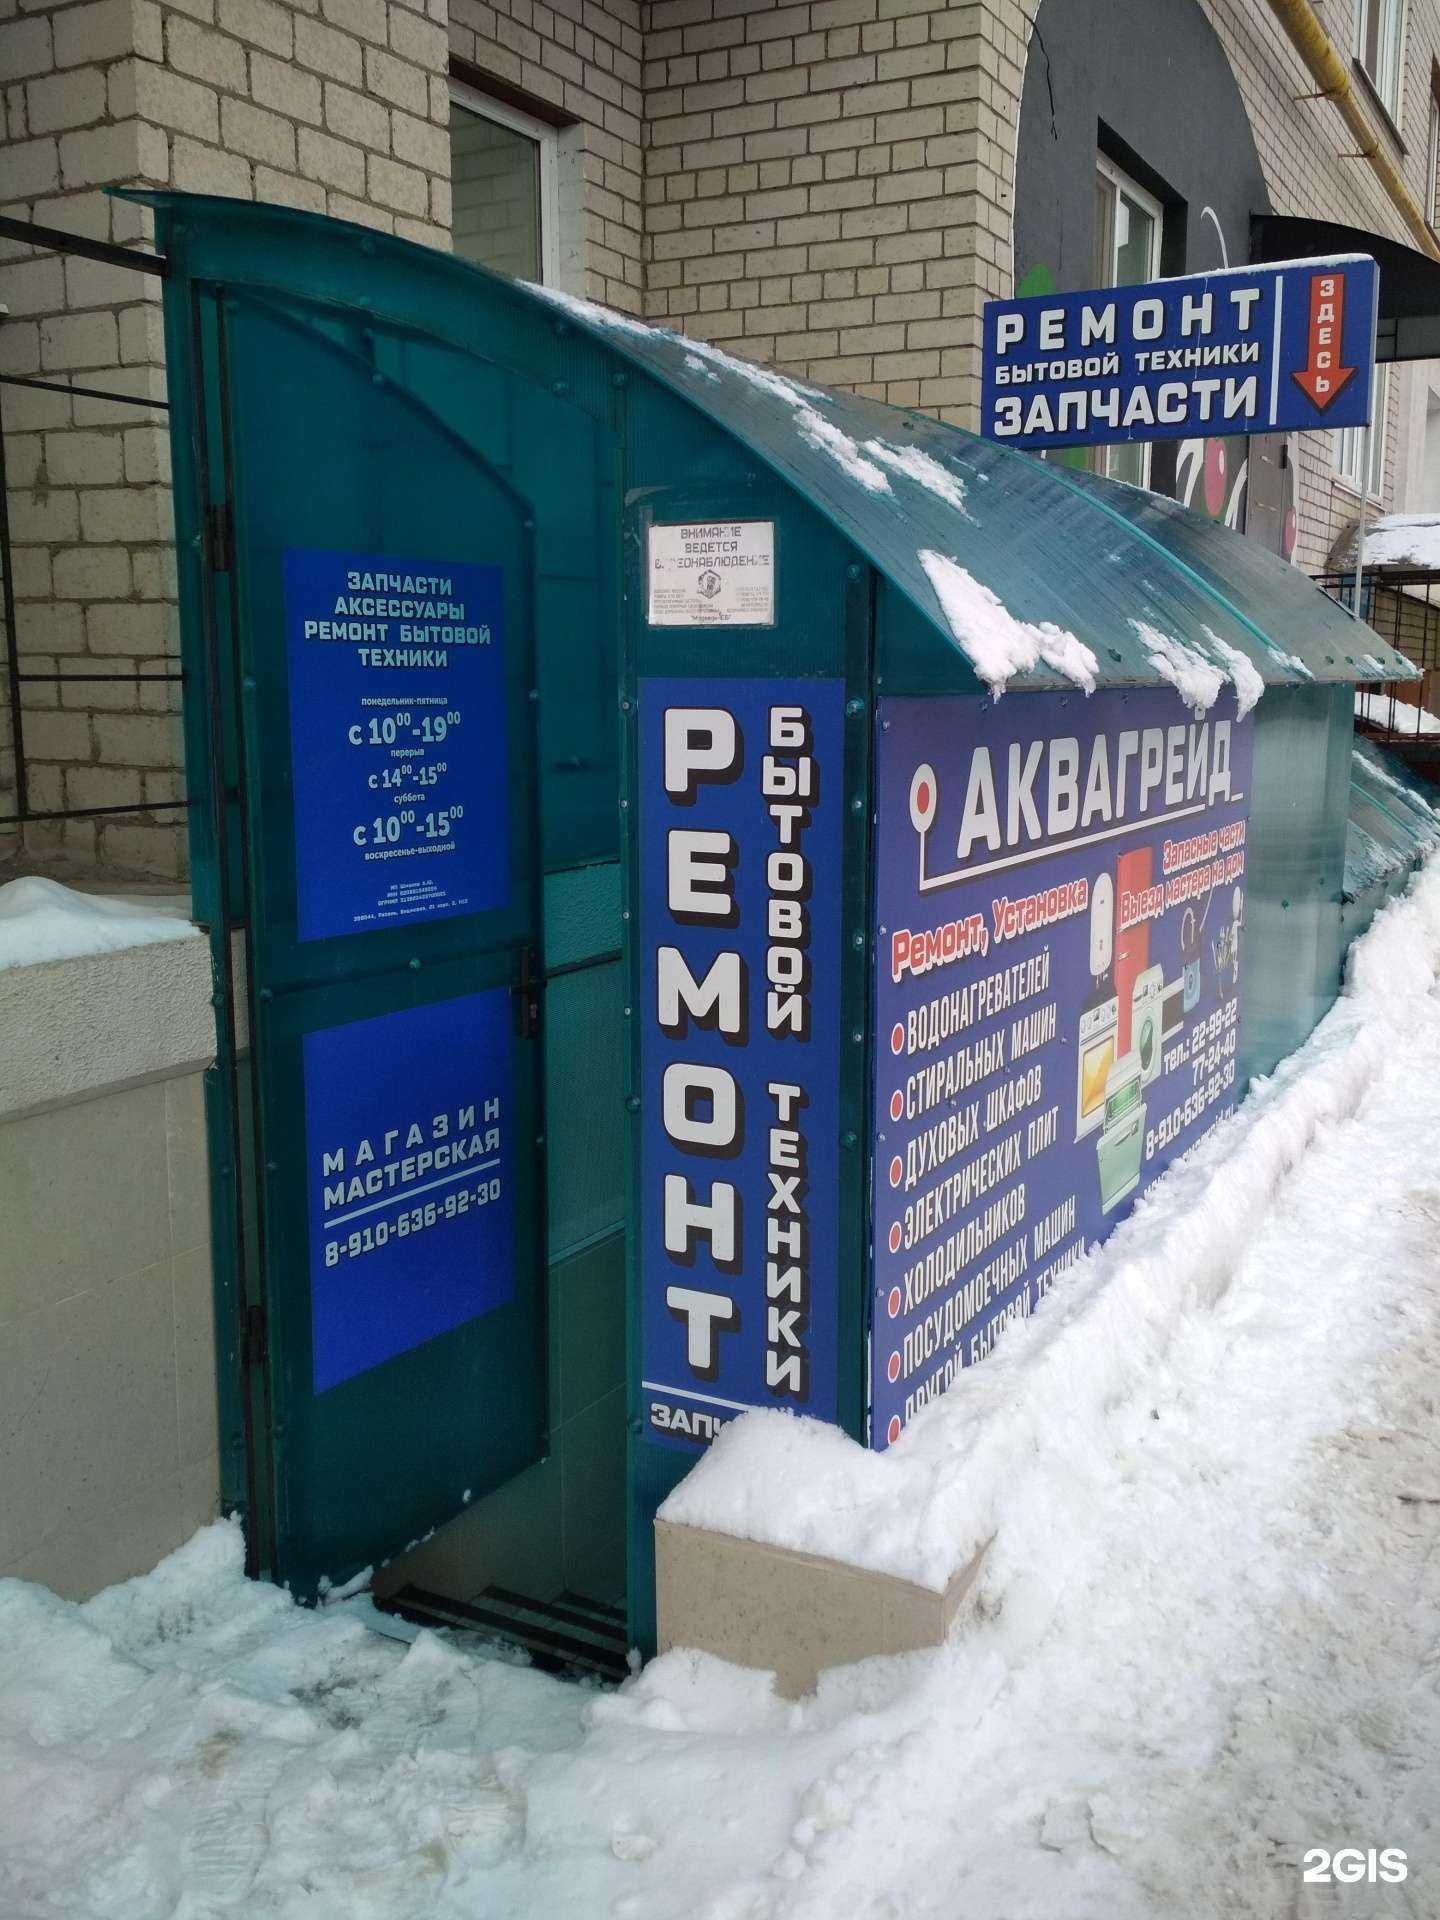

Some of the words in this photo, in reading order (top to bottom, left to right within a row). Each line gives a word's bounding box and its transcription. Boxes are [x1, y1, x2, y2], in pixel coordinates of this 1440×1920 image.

[995, 352, 1120, 385] БЫТОВОЙ
[1134, 341, 1260, 373] ТЕХНИКИ
[996, 287, 1261, 355] РЕМОНТ
[1314, 279, 1335, 393] ЗДЕСЬ
[993, 375, 1258, 437] ЗАПЧАСТИ
[347, 571, 453, 596] ЗАПЧАСТИ
[685, 541, 738, 554] ВЕДЕТСЯ
[304, 620, 389, 642] РЕМОНТ
[400, 624, 491, 645] БЫТОВОЙ
[334, 596, 465, 620] АКСЕССУАРЫ
[358, 648, 448, 667] ТЕХНИКИ
[394, 792, 426, 805] суббота
[957, 707, 1232, 858] АКВАГРЕЙД
[762, 706, 811, 1033] БЫТОВОЙ
[1163, 830, 1218, 875] Запасные
[1218, 819, 1246, 852] части
[892, 913, 989, 983] Ремонт,
[992, 877, 1089, 944] Установка
[1119, 884, 1165, 932] Выезд
[1165, 865, 1211, 909] мастера
[1211, 858, 1225, 888] на
[1225, 850, 1245, 886] дом
[658, 708, 741, 1369] РЕМОНТ
[906, 945, 1051, 1056] ВОДОНАГРЕВАТЕЛЕЙ
[1191, 997, 1238, 1054] 22-99-22
[906, 1028, 1006, 1121] СТИРАЛЬНЫХ
[1010, 1002, 1057, 1062] МАШИН
[1192, 1027, 1236, 1086] 77-24-40
[323, 1097, 500, 1177] МАГАЗИН
[904, 1100, 980, 1192] ДУХОВЫХ
[986, 1064, 1043, 1133] ШКАФОВ
[1146, 1058, 1236, 1161] 8-910-636-92-30
[323, 1127, 501, 1212] МАСТЕРСКАЯ
[904, 1131, 1022, 1250] ЭЛЕКТРИЧЕСКИХ
[1027, 1106, 1060, 1160] ПЛИТ
[325, 1177, 501, 1268] 8-910-636-92-30
[765, 1082, 802, 1393] ТЕХНИКИ
[903, 1183, 1026, 1316] ХОЛОДИЛЬНИКОВ
[903, 1234, 1028, 1380] ПОСУДОМОЕЧНЫХ
[1034, 1195, 1077, 1262] МАШИН
